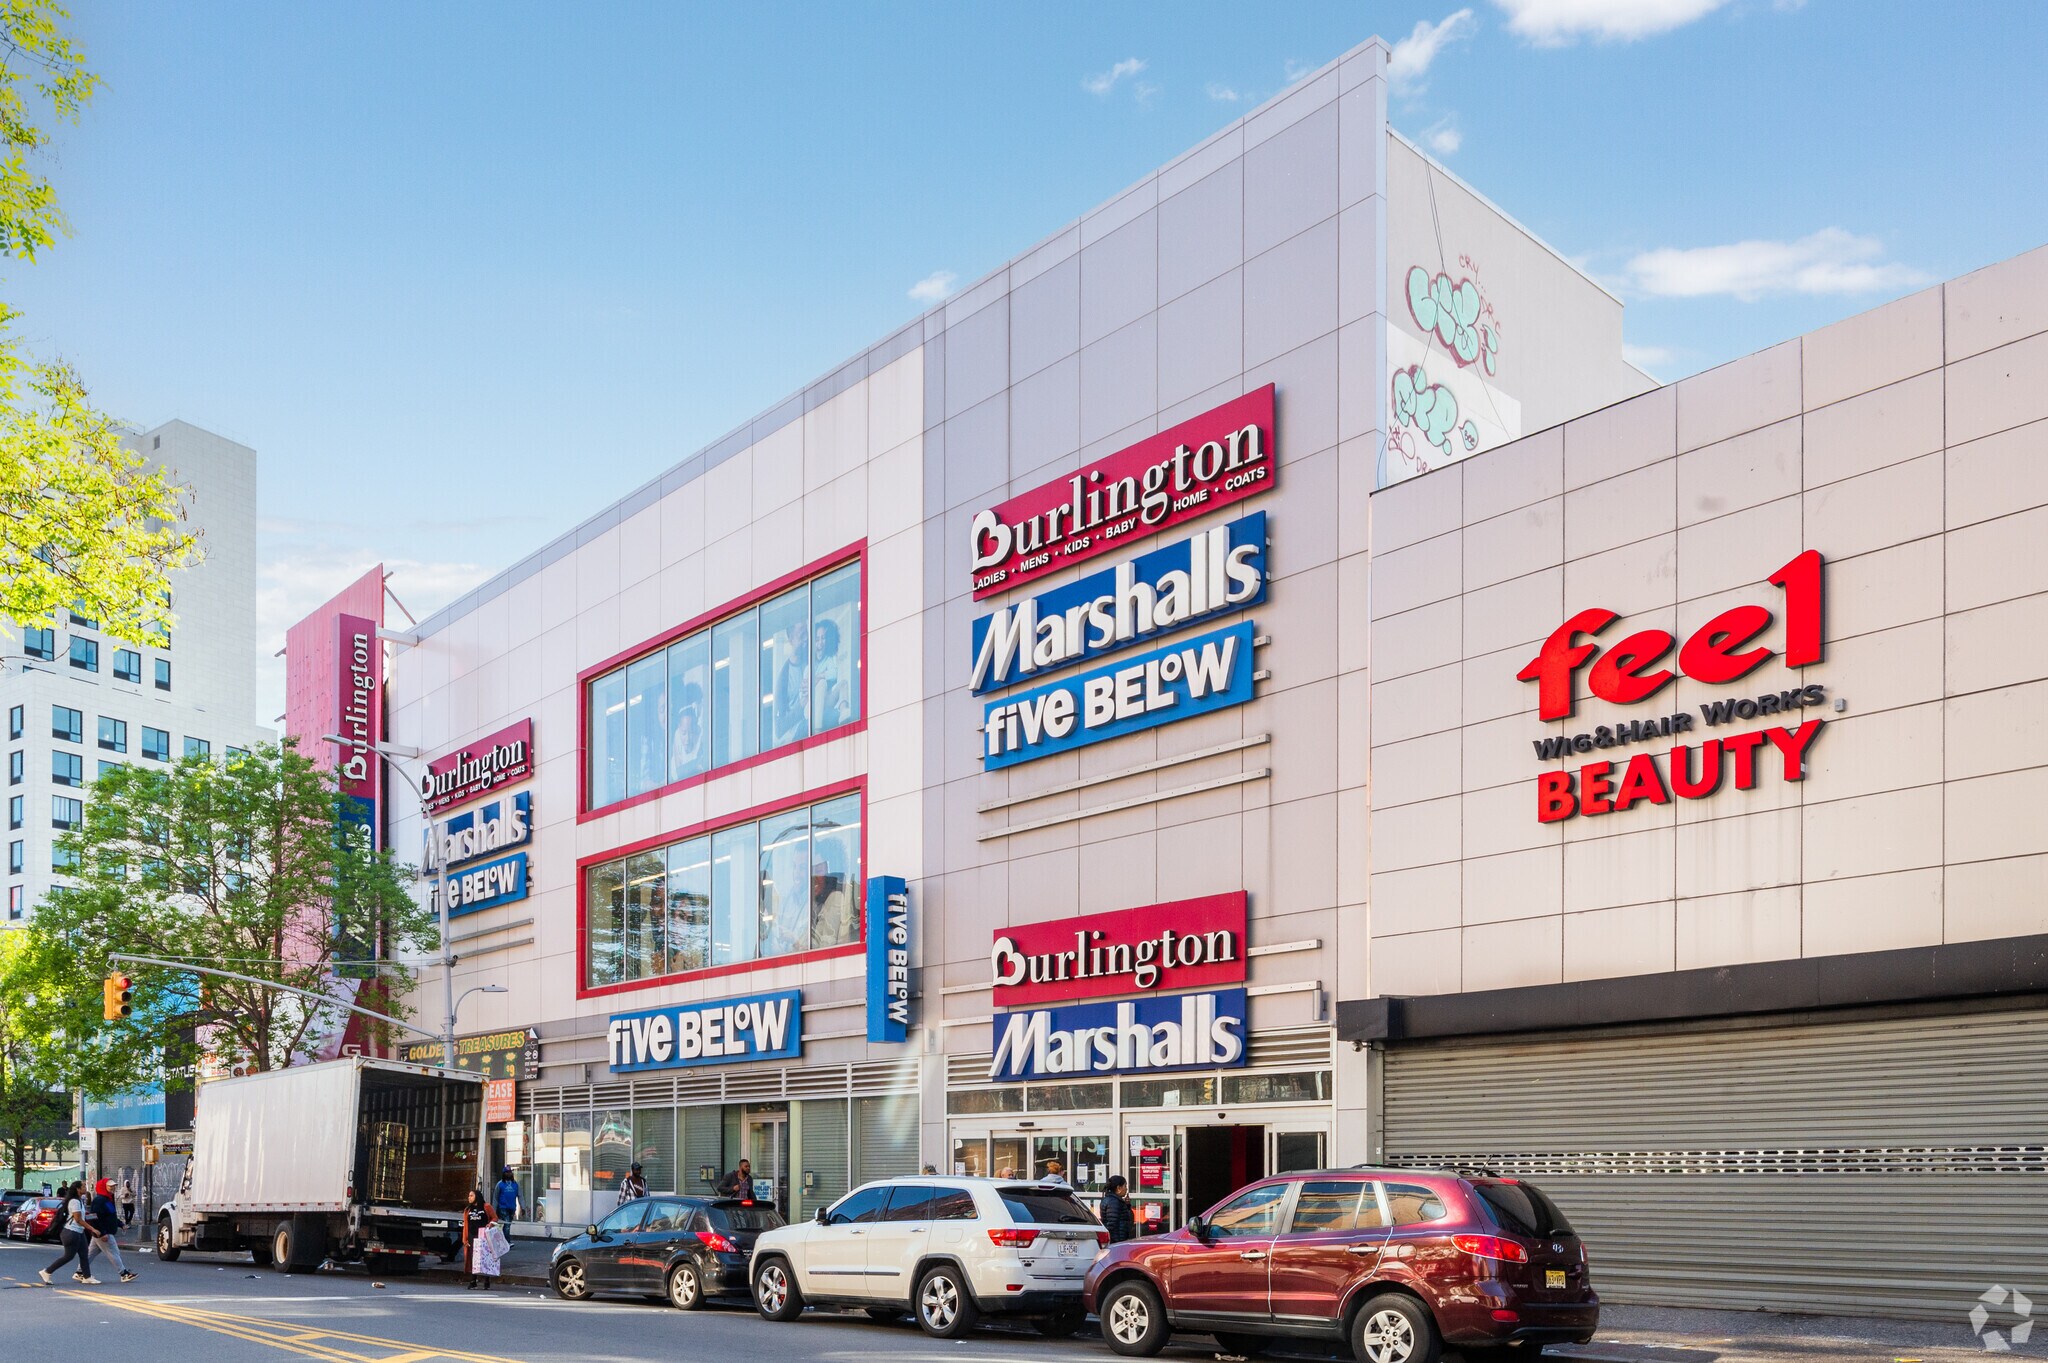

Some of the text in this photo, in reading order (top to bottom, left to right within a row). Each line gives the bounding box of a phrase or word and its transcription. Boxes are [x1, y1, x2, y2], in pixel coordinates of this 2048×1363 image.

[970, 423, 1265, 574] Burlington
[972, 466, 1266, 592] LADIES MENS KIDS BABY HOME COATS
[968, 524, 1262, 692] Marshalls
[1517, 549, 1826, 723] feel
[343, 633, 375, 782] Burlington
[985, 688, 1080, 757] five
[1700, 684, 1826, 726] WORKS
[420, 739, 525, 801] Burlington
[511, 765, 526, 776] COATS
[1538, 718, 1827, 824] BEAUTY
[420, 796, 528, 874] Marshalls
[427, 878, 461, 914] fie
[888, 893, 908, 944] five
[991, 929, 1236, 989] Burlington
[458, 1031, 525, 1055] TREASURES
[607, 1014, 673, 1066] five
[988, 993, 1243, 1077] Marshalls
[488, 1082, 513, 1099] EASE
[507, 1064, 515, 1077] $9
